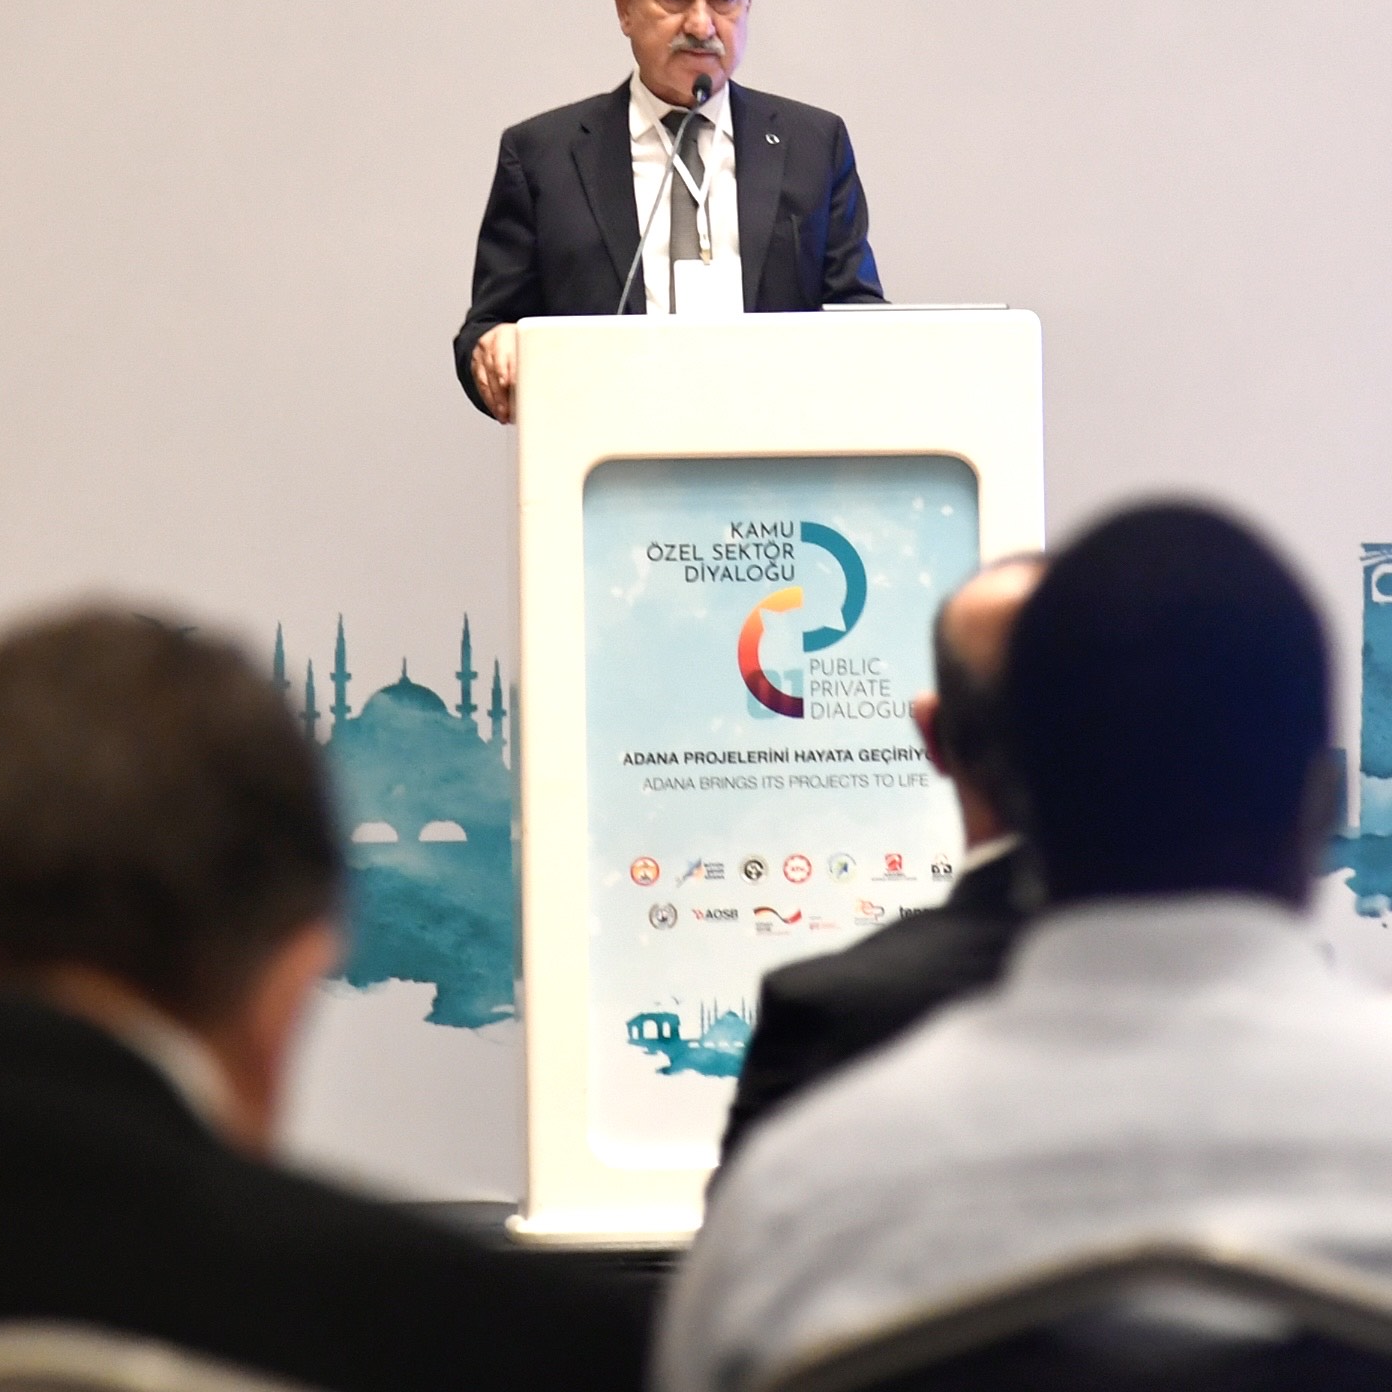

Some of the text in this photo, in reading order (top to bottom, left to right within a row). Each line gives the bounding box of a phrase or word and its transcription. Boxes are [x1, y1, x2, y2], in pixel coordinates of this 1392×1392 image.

[730, 521, 794, 539] KAMU
[646, 540, 795, 562] ÖZEL SEKTÖR
[684, 561, 795, 583] DİYALOĞU
[809, 657, 881, 676] PUBLIC
[810, 679, 891, 697] PRIVATE
[622, 751, 679, 766] ADANA
[683, 747, 790, 765] PROJELERİNİ
[794, 749, 855, 763] HAYATA
[642, 772, 929, 791] ADANA BRINGS ITS PROJECTS TO LIFE
